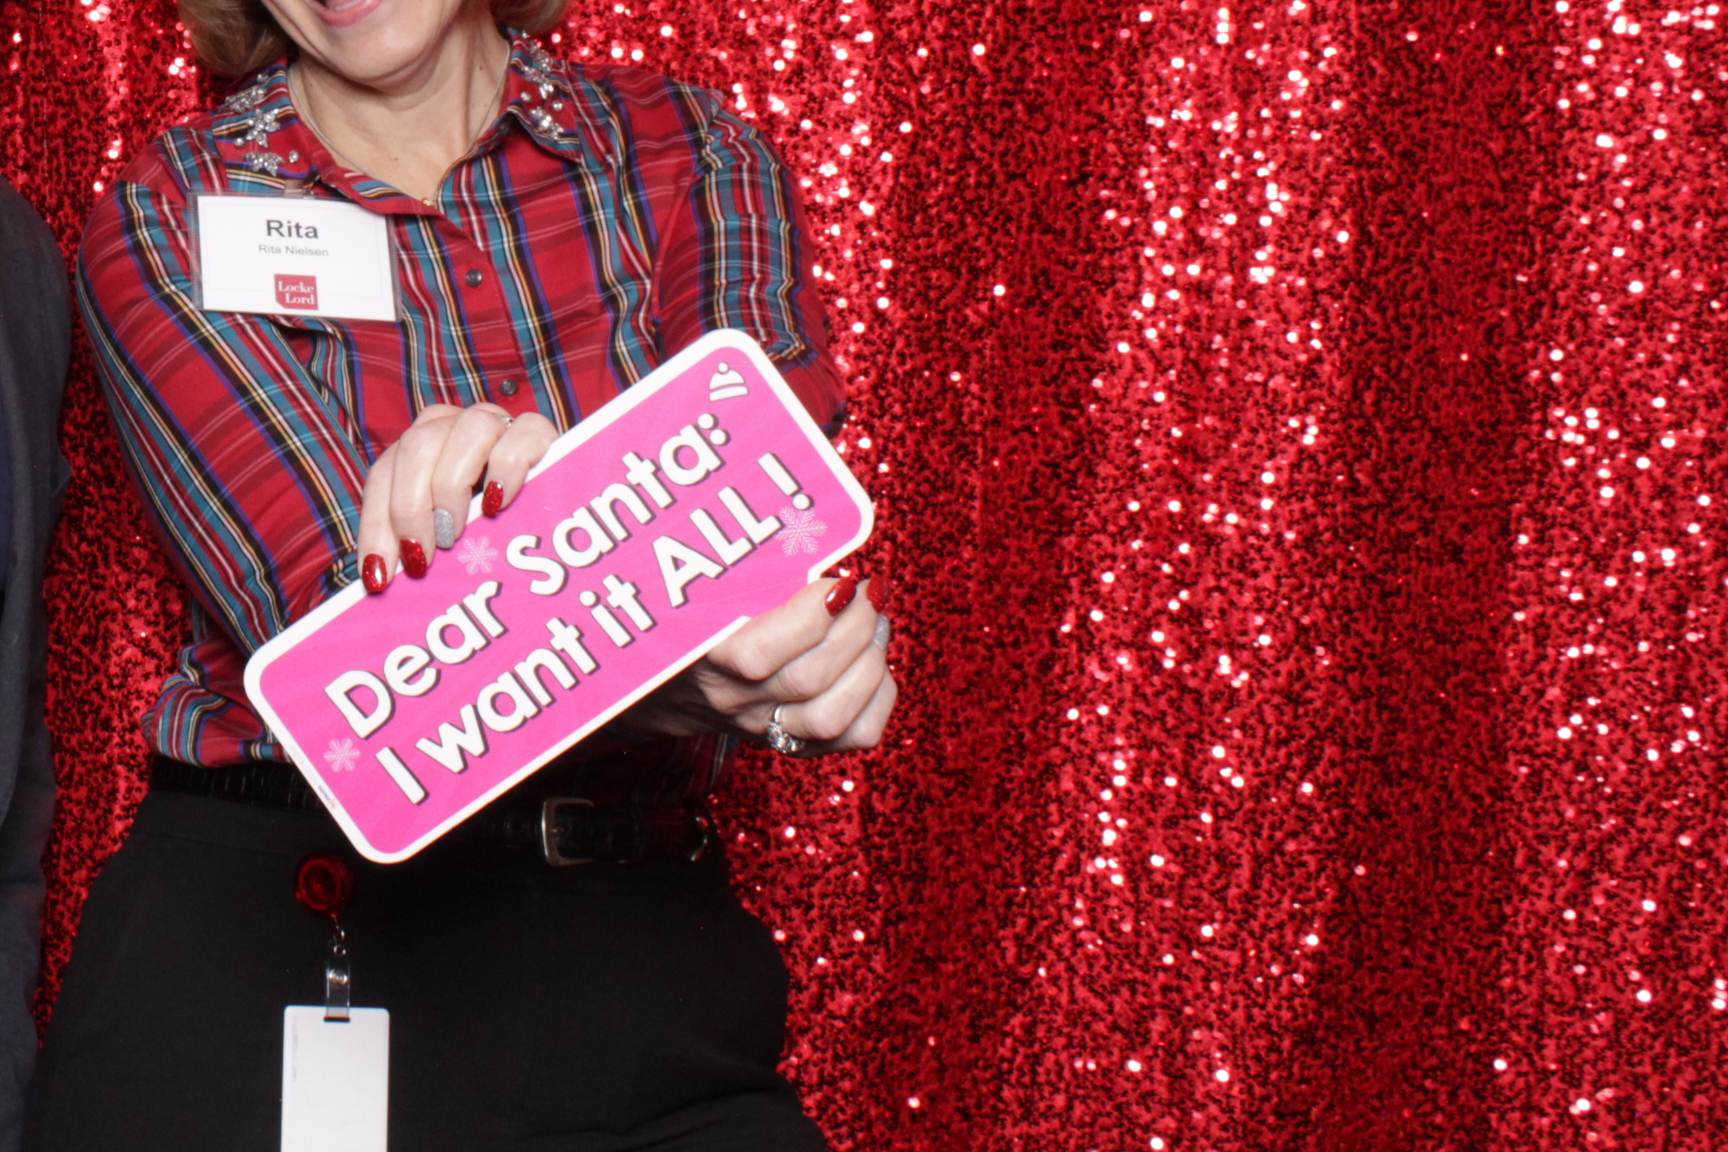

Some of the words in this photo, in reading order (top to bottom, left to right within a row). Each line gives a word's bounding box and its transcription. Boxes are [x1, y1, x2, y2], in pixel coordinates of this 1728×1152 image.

[266, 219, 319, 239] Rita
[258, 244, 281, 254] Rita
[285, 245, 329, 256] Nielsen
[278, 281, 314, 293] Locke
[285, 293, 315, 305] Lord
[323, 580, 507, 739] Dear
[505, 412, 729, 596] Santa:
[375, 746, 429, 806] I
[415, 617, 599, 775] want
[578, 574, 654, 648] it
